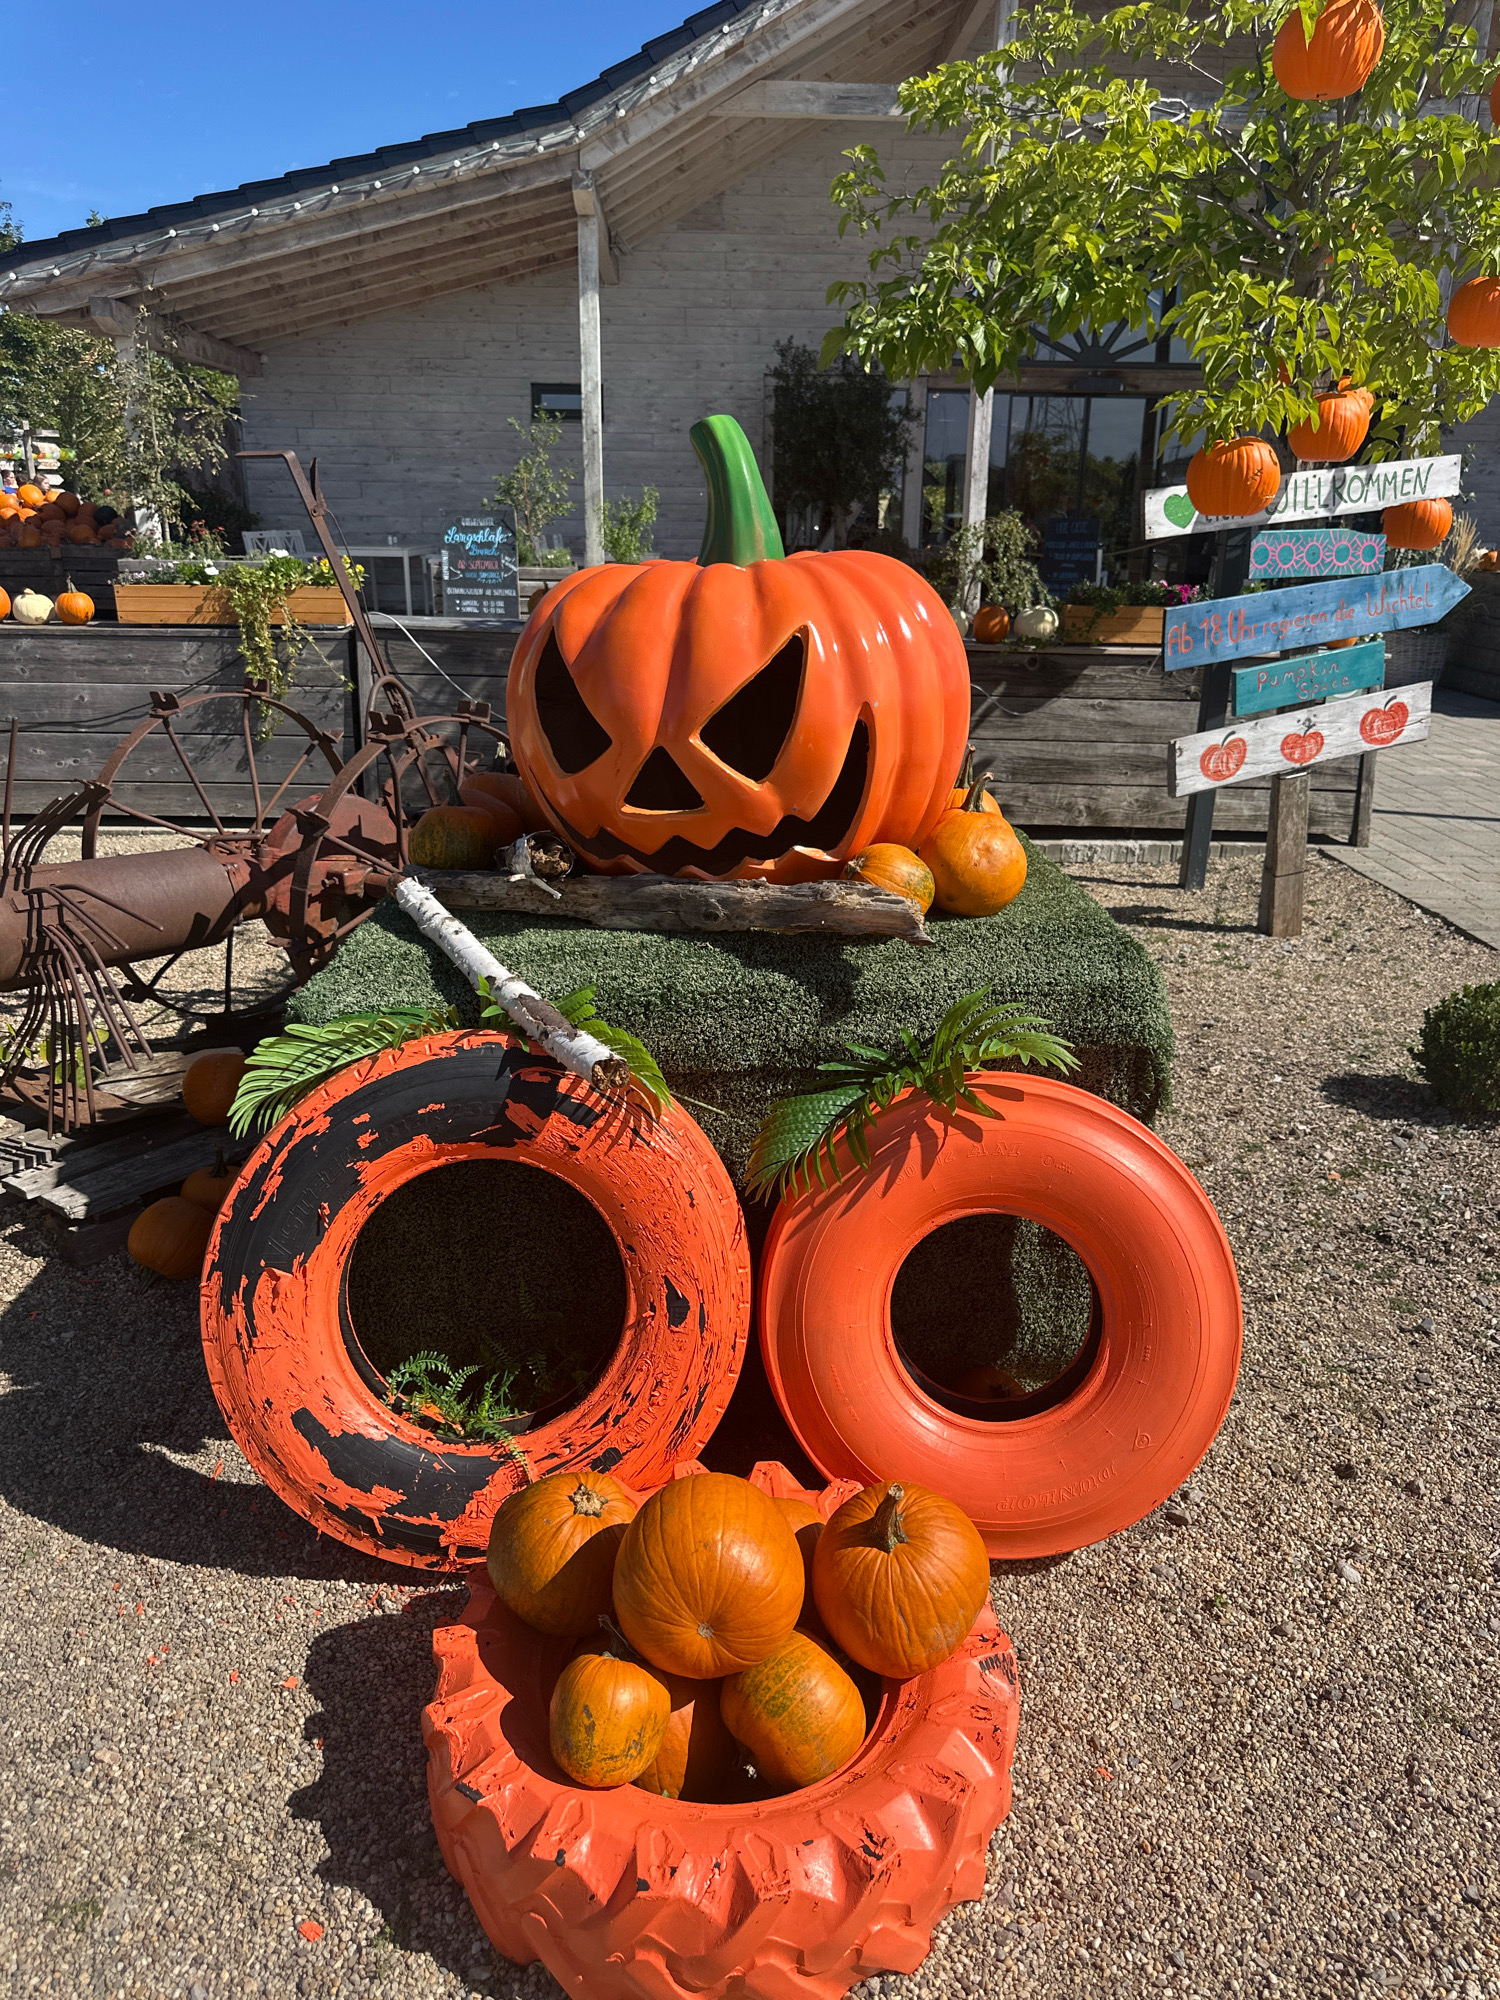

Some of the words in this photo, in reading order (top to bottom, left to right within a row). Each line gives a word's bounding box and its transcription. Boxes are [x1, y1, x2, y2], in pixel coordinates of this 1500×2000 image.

[1168, 624, 1194, 657] Ab
[1199, 614, 1224, 650] 18
[1228, 609, 1258, 644] Uhr
[1261, 609, 1328, 641] regieren
[1334, 598, 1356, 622] die
[1366, 582, 1434, 617] Wichtel
[1298, 676, 1353, 702] Spice
[996, 1461, 1118, 1514] DUNLOP
